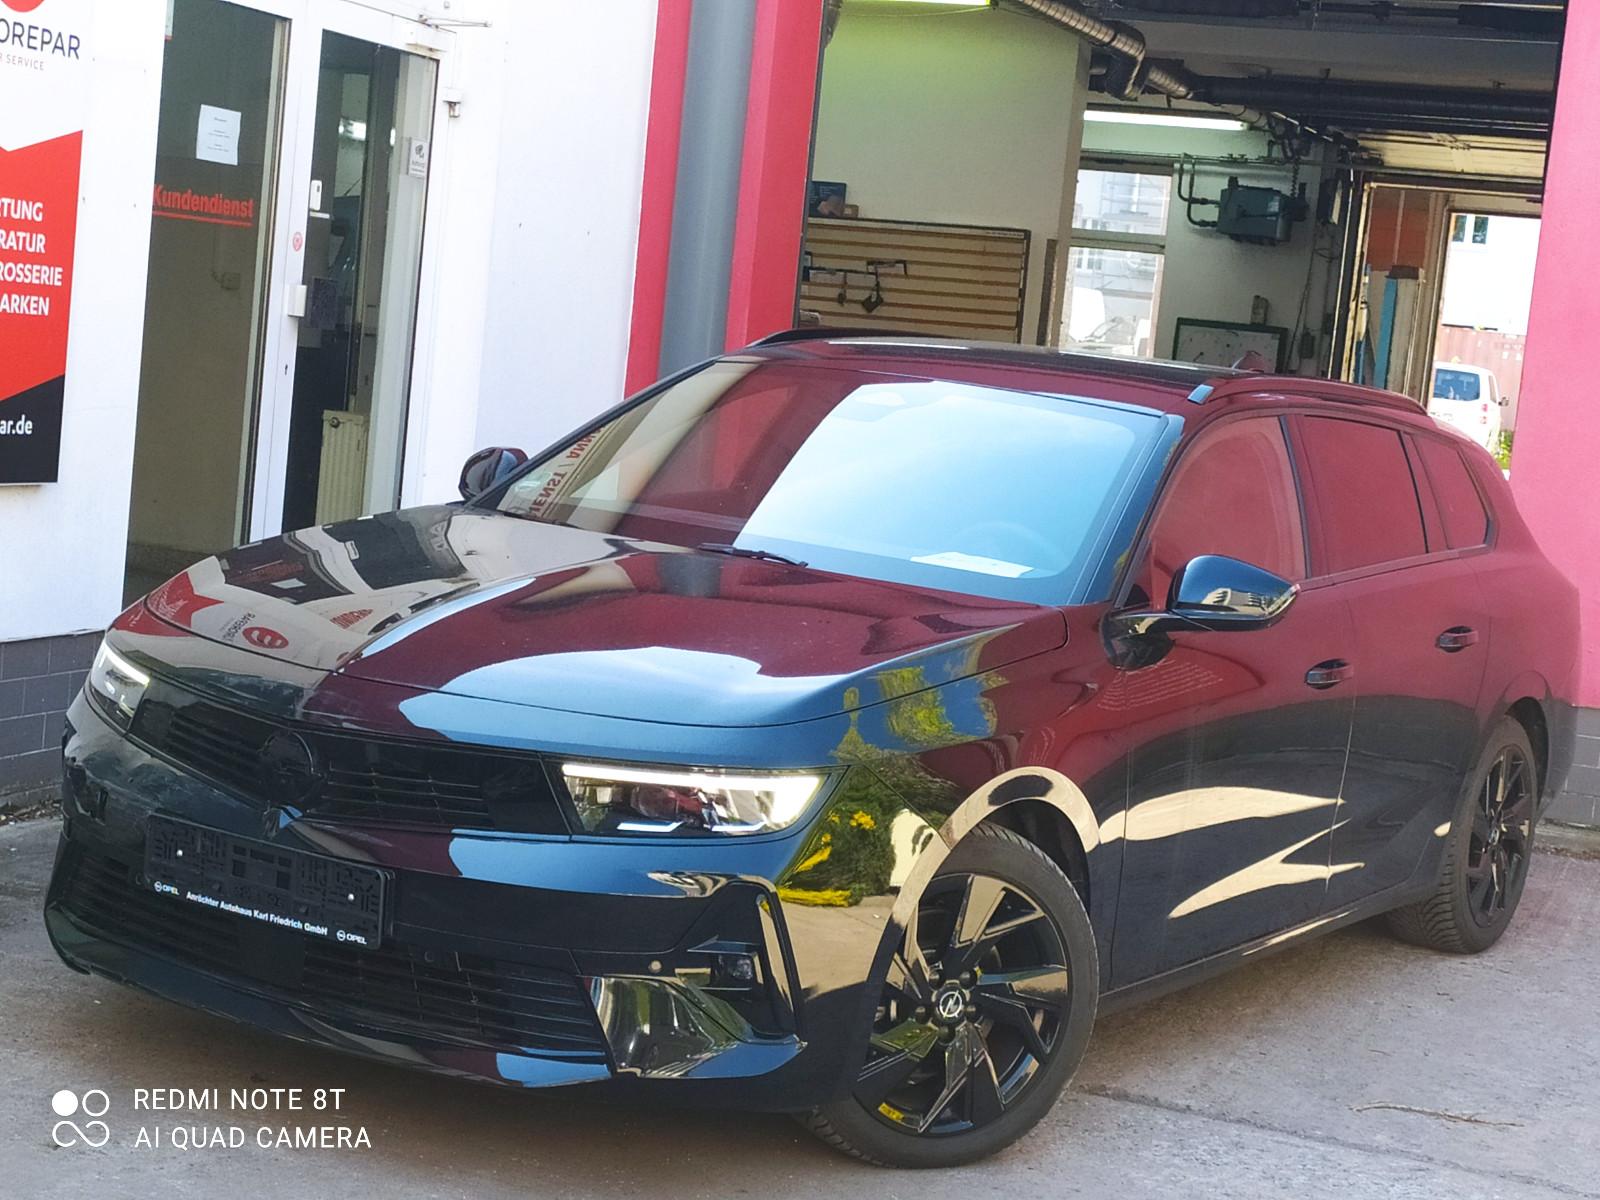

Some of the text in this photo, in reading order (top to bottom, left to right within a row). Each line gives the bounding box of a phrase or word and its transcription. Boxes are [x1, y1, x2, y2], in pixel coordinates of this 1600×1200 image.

[0, 18, 80, 60] OREPAR
[6, 53, 44, 71] SERVICE
[0, 197, 43, 222] TUNG
[154, 184, 253, 217] Kundendienst
[0, 414, 33, 435] ar.de
[162, 884, 179, 896] OPEL
[220, 901, 252, 917] Autohaus
[253, 910, 269, 921] Karl
[270, 913, 302, 930] Friedrich
[304, 923, 328, 936] GmbH
[346, 933, 367, 945] OPEL
